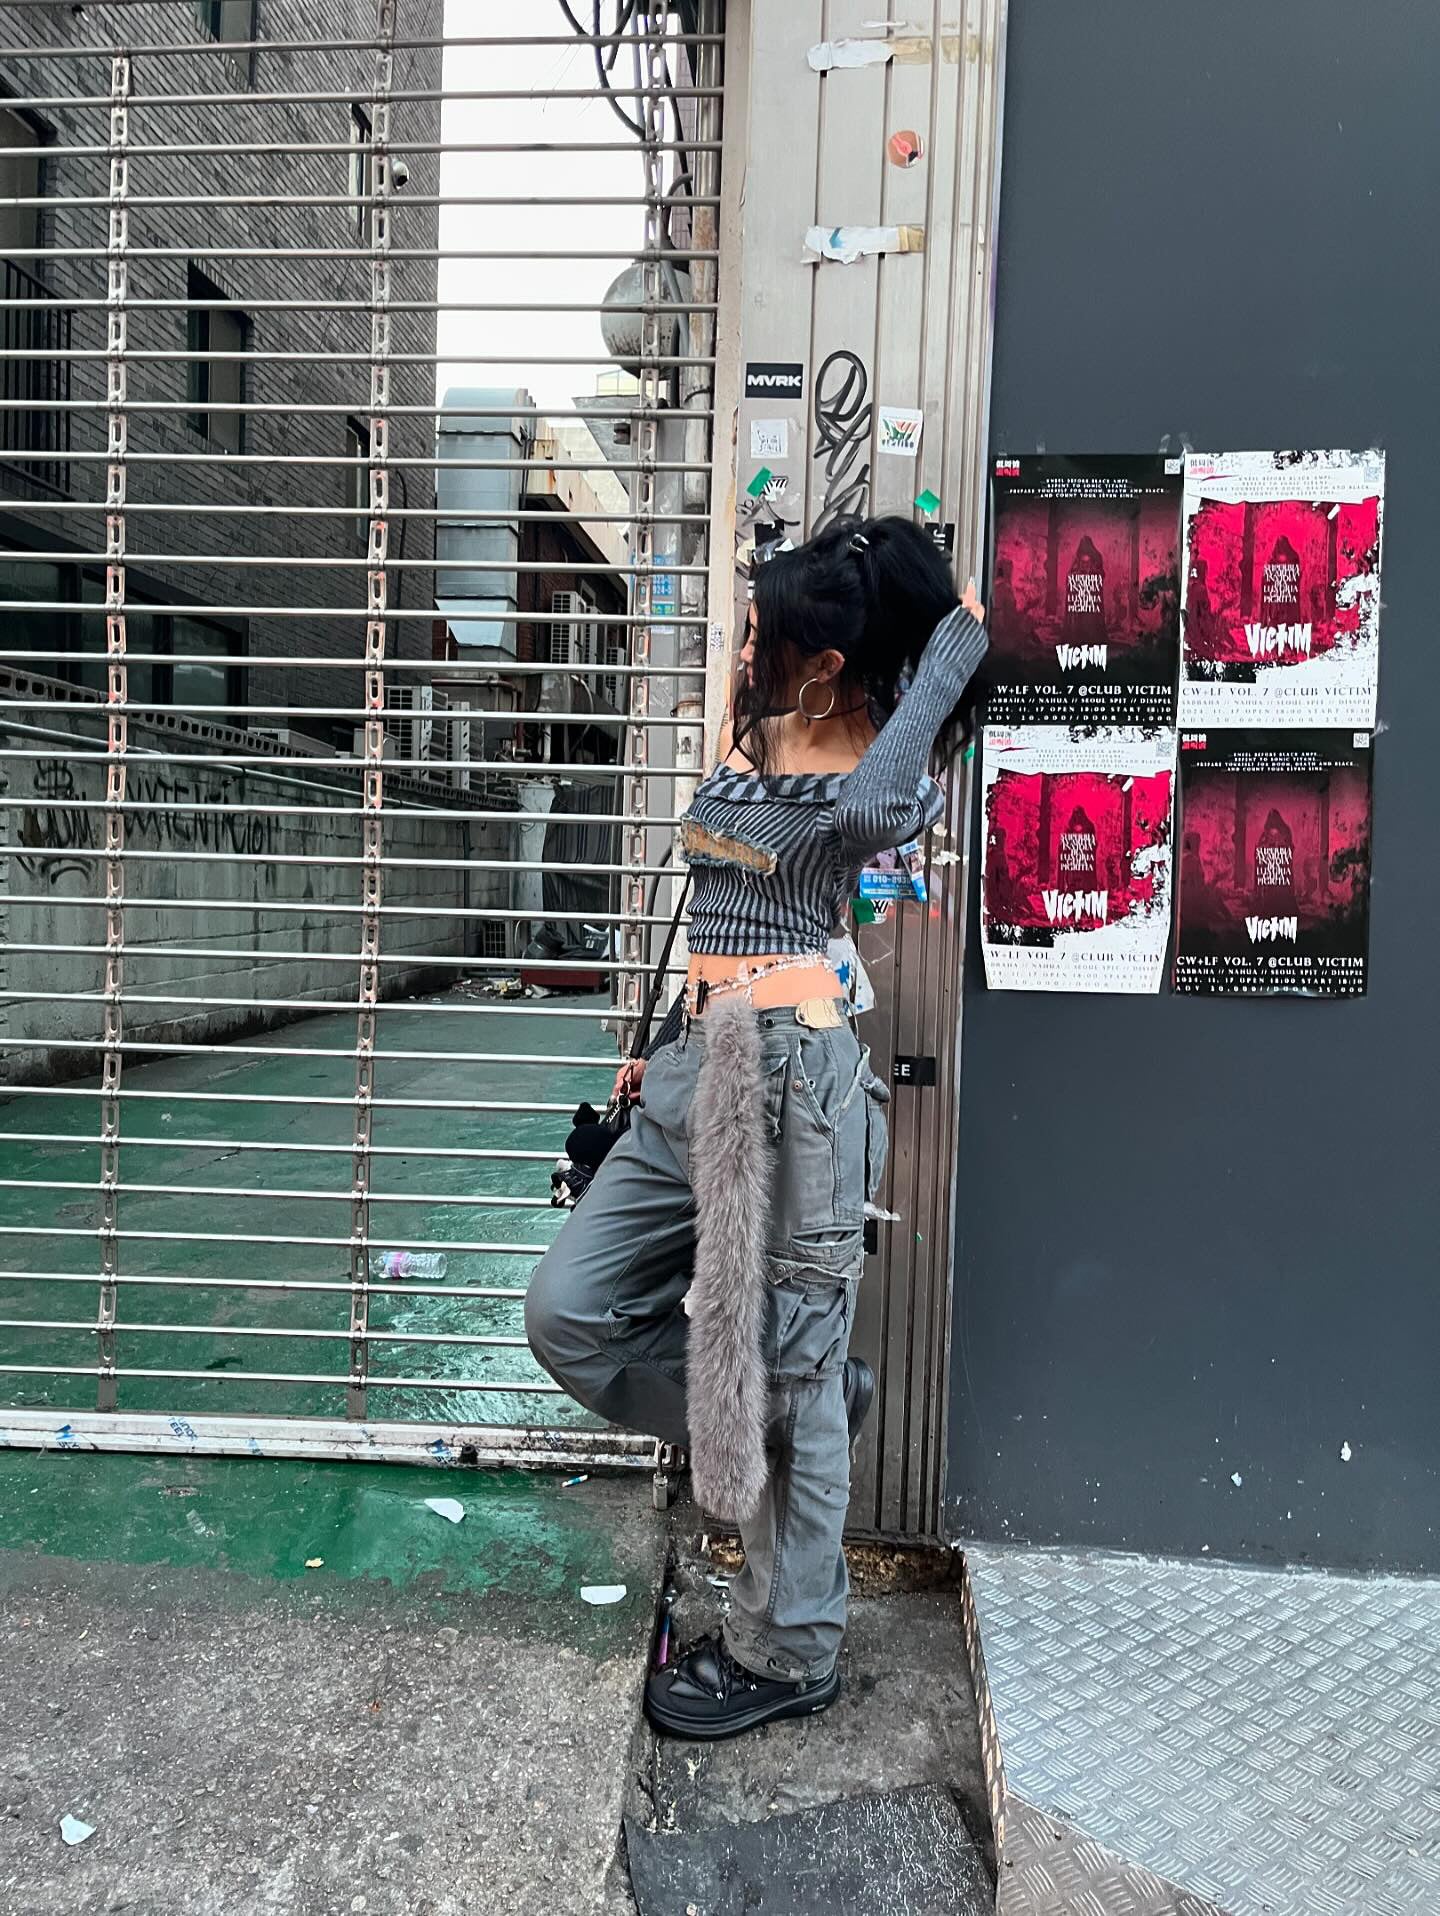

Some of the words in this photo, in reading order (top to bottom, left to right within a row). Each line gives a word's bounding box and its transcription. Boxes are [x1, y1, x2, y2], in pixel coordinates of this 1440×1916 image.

[747, 375, 802, 388] MVRK
[1244, 622, 1313, 660] VICTIM
[1056, 643, 1108, 673] VICTIM
[1034, 685, 1062, 696] VOL.
[1078, 685, 1122, 697] @CLUB
[1126, 685, 1172, 696] VICTIM
[1042, 888, 1108, 925] VICTIM
[1245, 915, 1298, 944] VICTIM
[1176, 956, 1218, 966] CW+LF
[1223, 956, 1252, 966] VOL.
[1268, 957, 1312, 968] @CLUB
[1317, 957, 1363, 967] VICTIM
